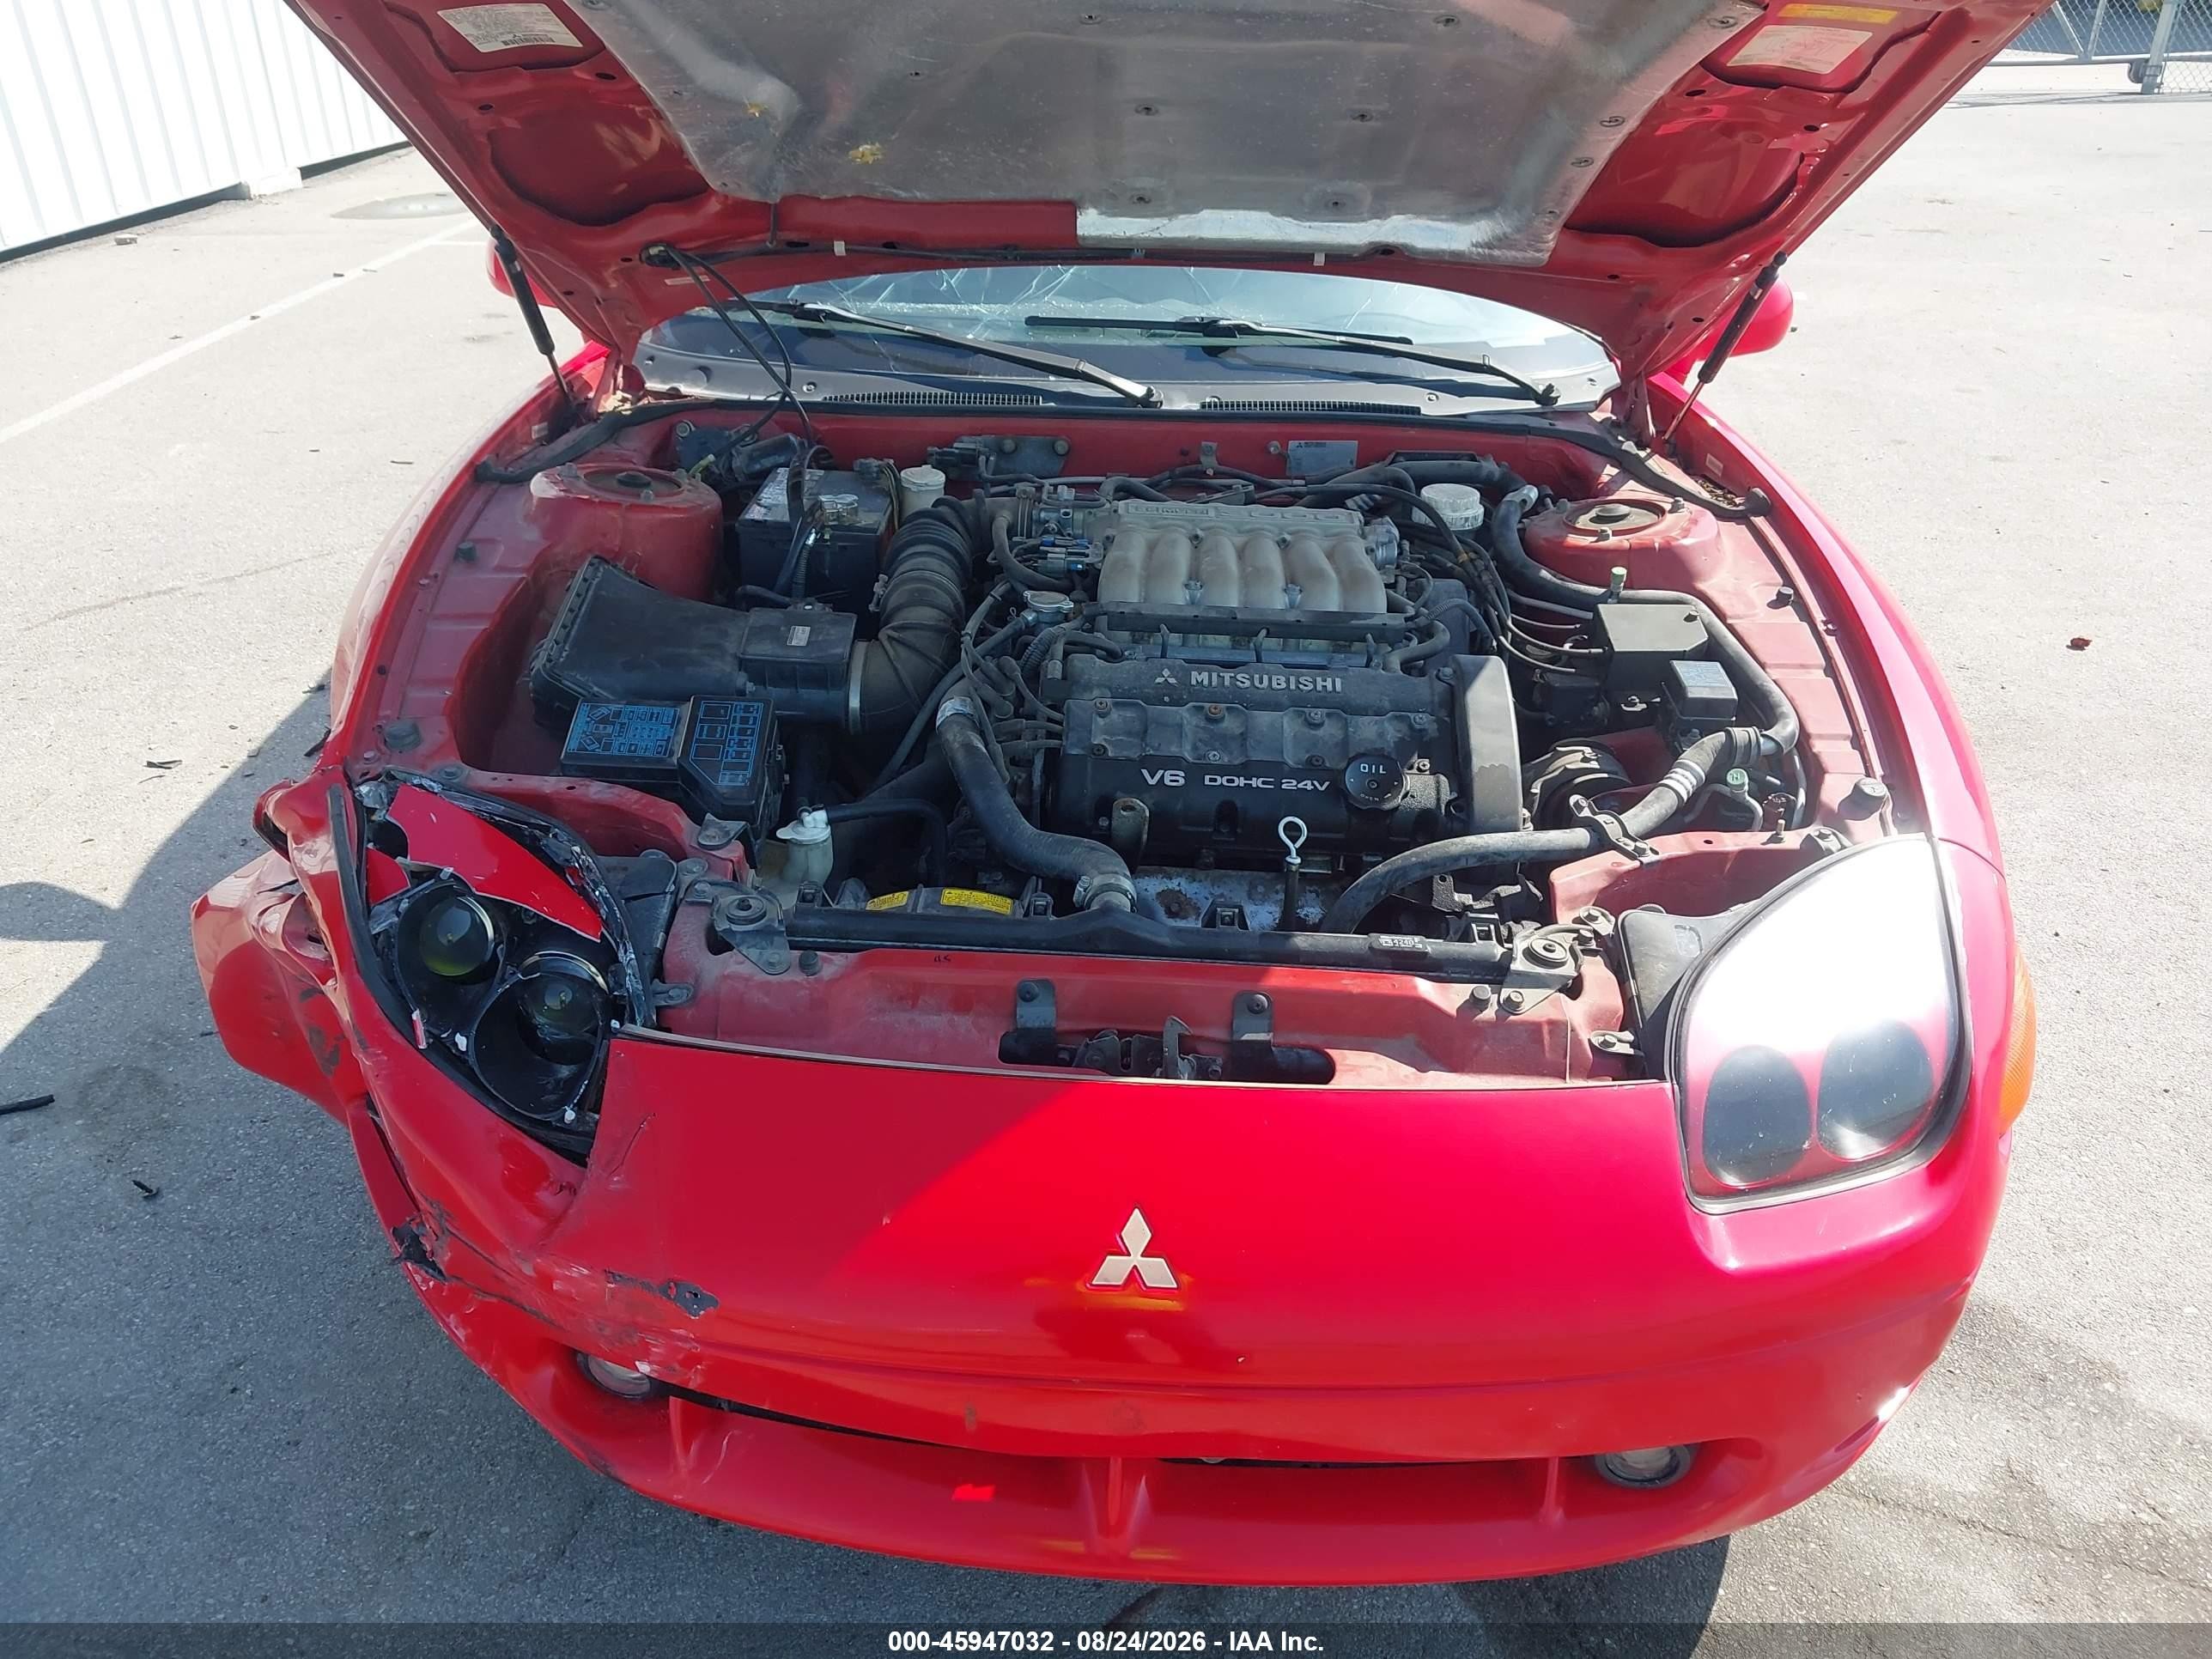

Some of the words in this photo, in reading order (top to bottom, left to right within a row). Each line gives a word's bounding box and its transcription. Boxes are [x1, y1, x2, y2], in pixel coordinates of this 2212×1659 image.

[1190, 671, 1343, 692] MITSUBISHI
[1360, 763, 1387, 774] OIL
[1141, 769, 1186, 787] V6
[1204, 775, 1274, 789] DOHC
[1280, 778, 1331, 792] 24V
